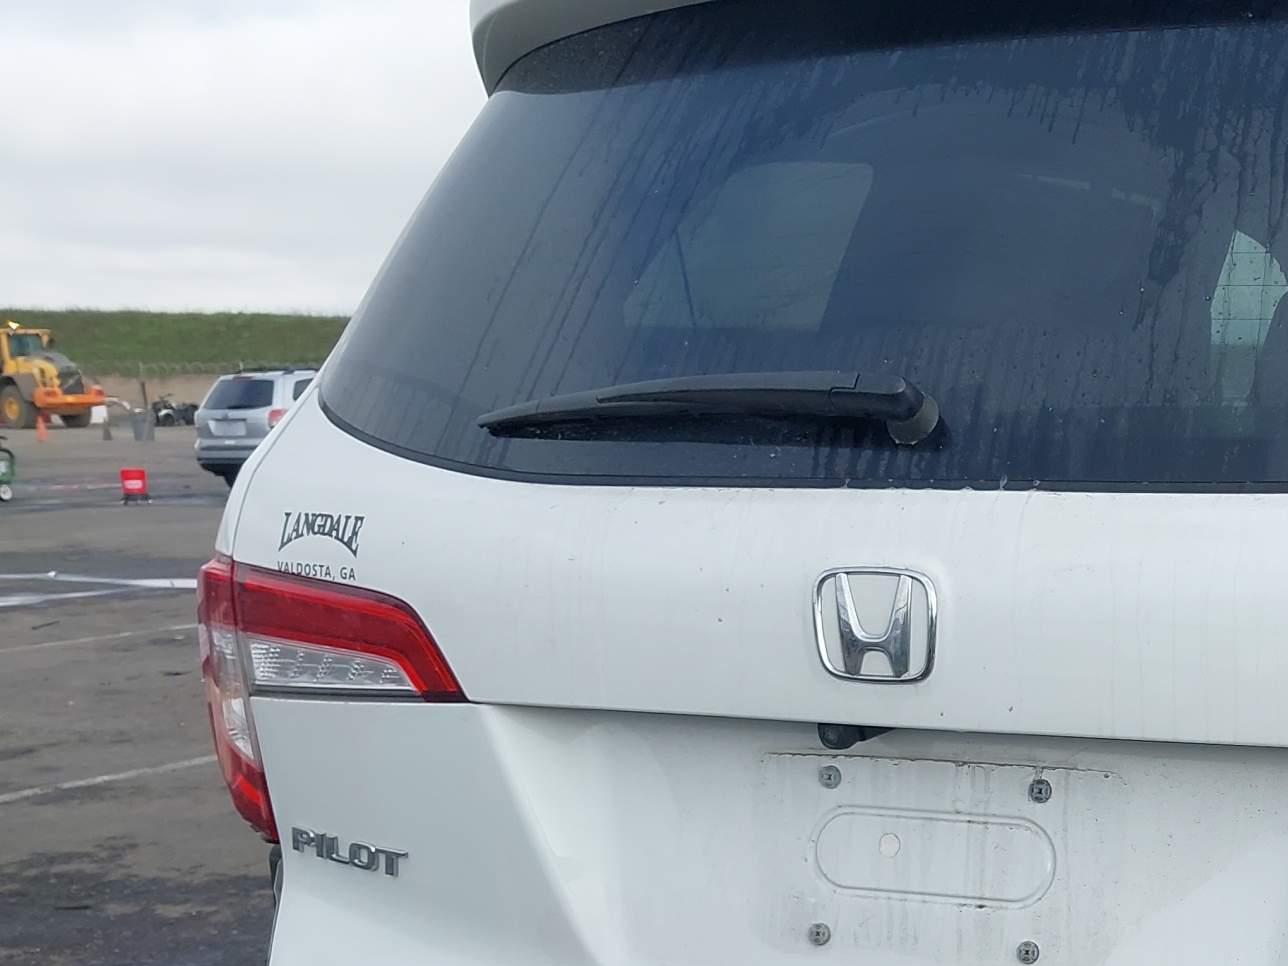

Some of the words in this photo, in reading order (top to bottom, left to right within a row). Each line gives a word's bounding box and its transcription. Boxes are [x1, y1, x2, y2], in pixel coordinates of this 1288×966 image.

[278, 511, 365, 558] LANGDALE
[340, 567, 356, 581] GA
[291, 826, 408, 877] PILOT
